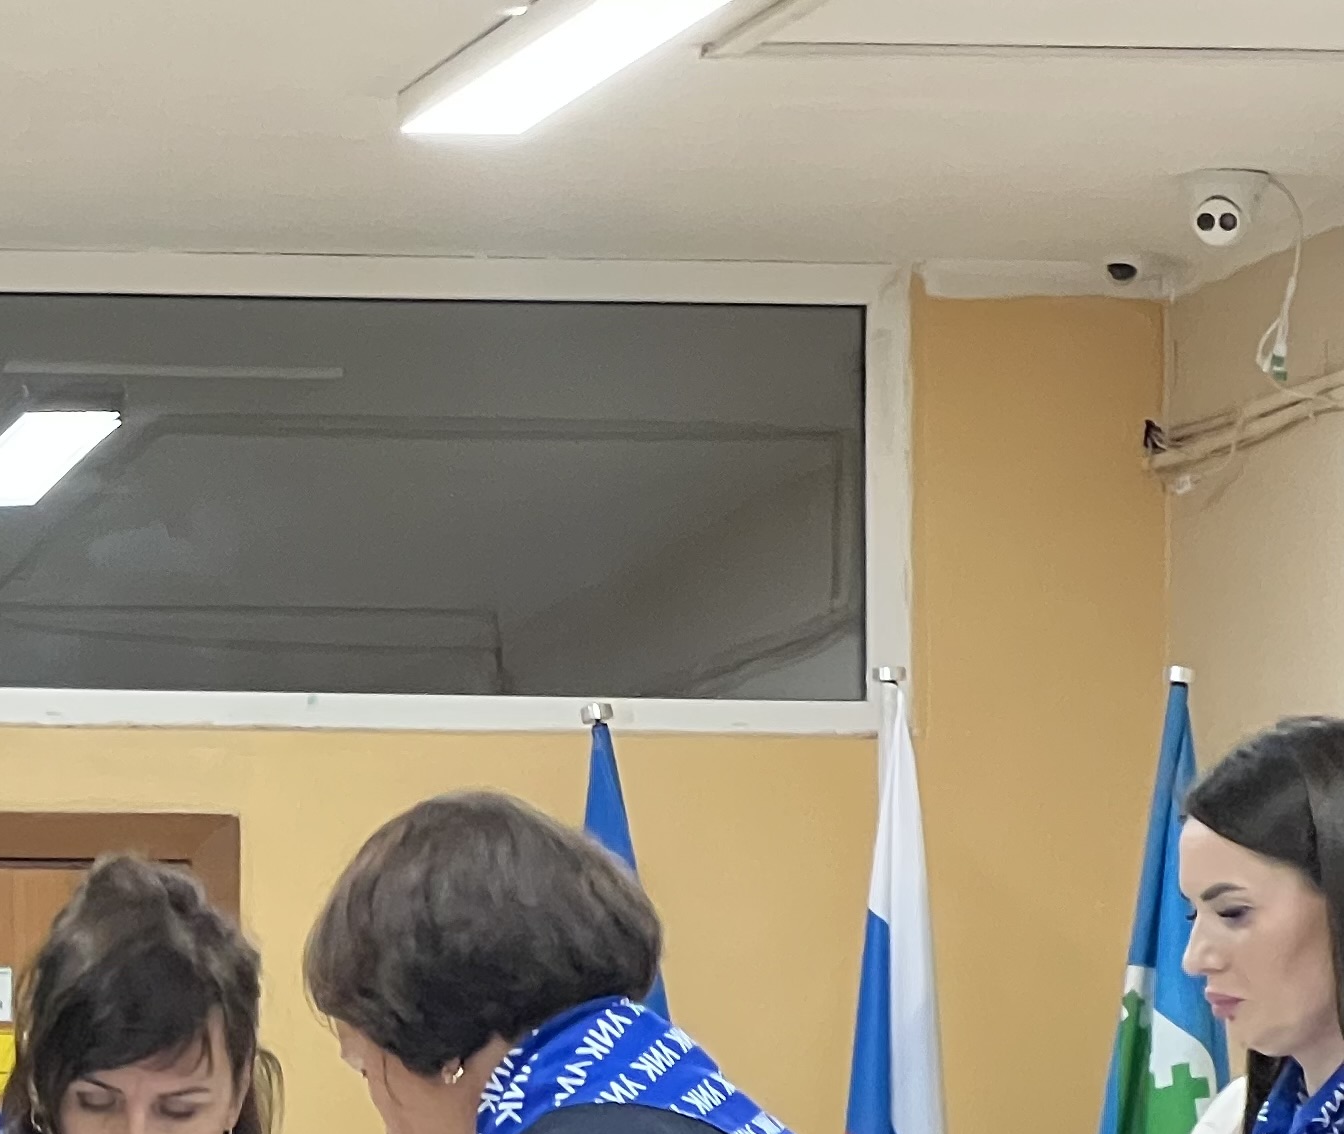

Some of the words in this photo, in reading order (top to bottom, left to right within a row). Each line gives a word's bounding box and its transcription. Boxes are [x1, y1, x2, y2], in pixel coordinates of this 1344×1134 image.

[575, 1008, 633, 1060] УИК
[629, 1039, 681, 1082] УИК
[681, 1078, 727, 1115] УИК
